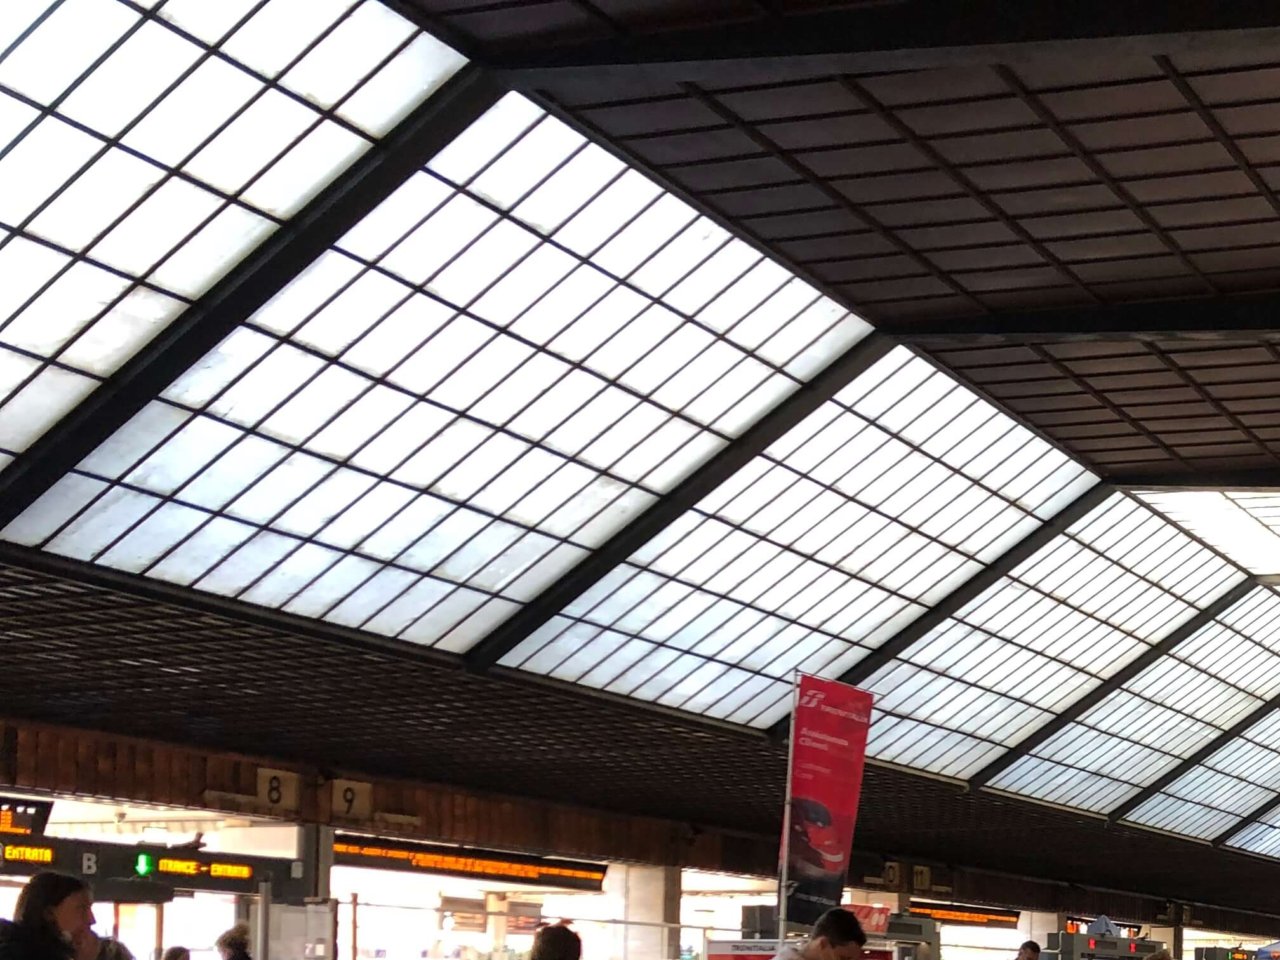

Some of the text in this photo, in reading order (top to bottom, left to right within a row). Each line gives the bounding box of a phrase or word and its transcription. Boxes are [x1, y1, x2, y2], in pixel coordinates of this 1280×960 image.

[267, 776, 282, 804] 8
[343, 787, 355, 815] 9
[4, 845, 53, 863] ENTRATA
[82, 853, 98, 875] B
